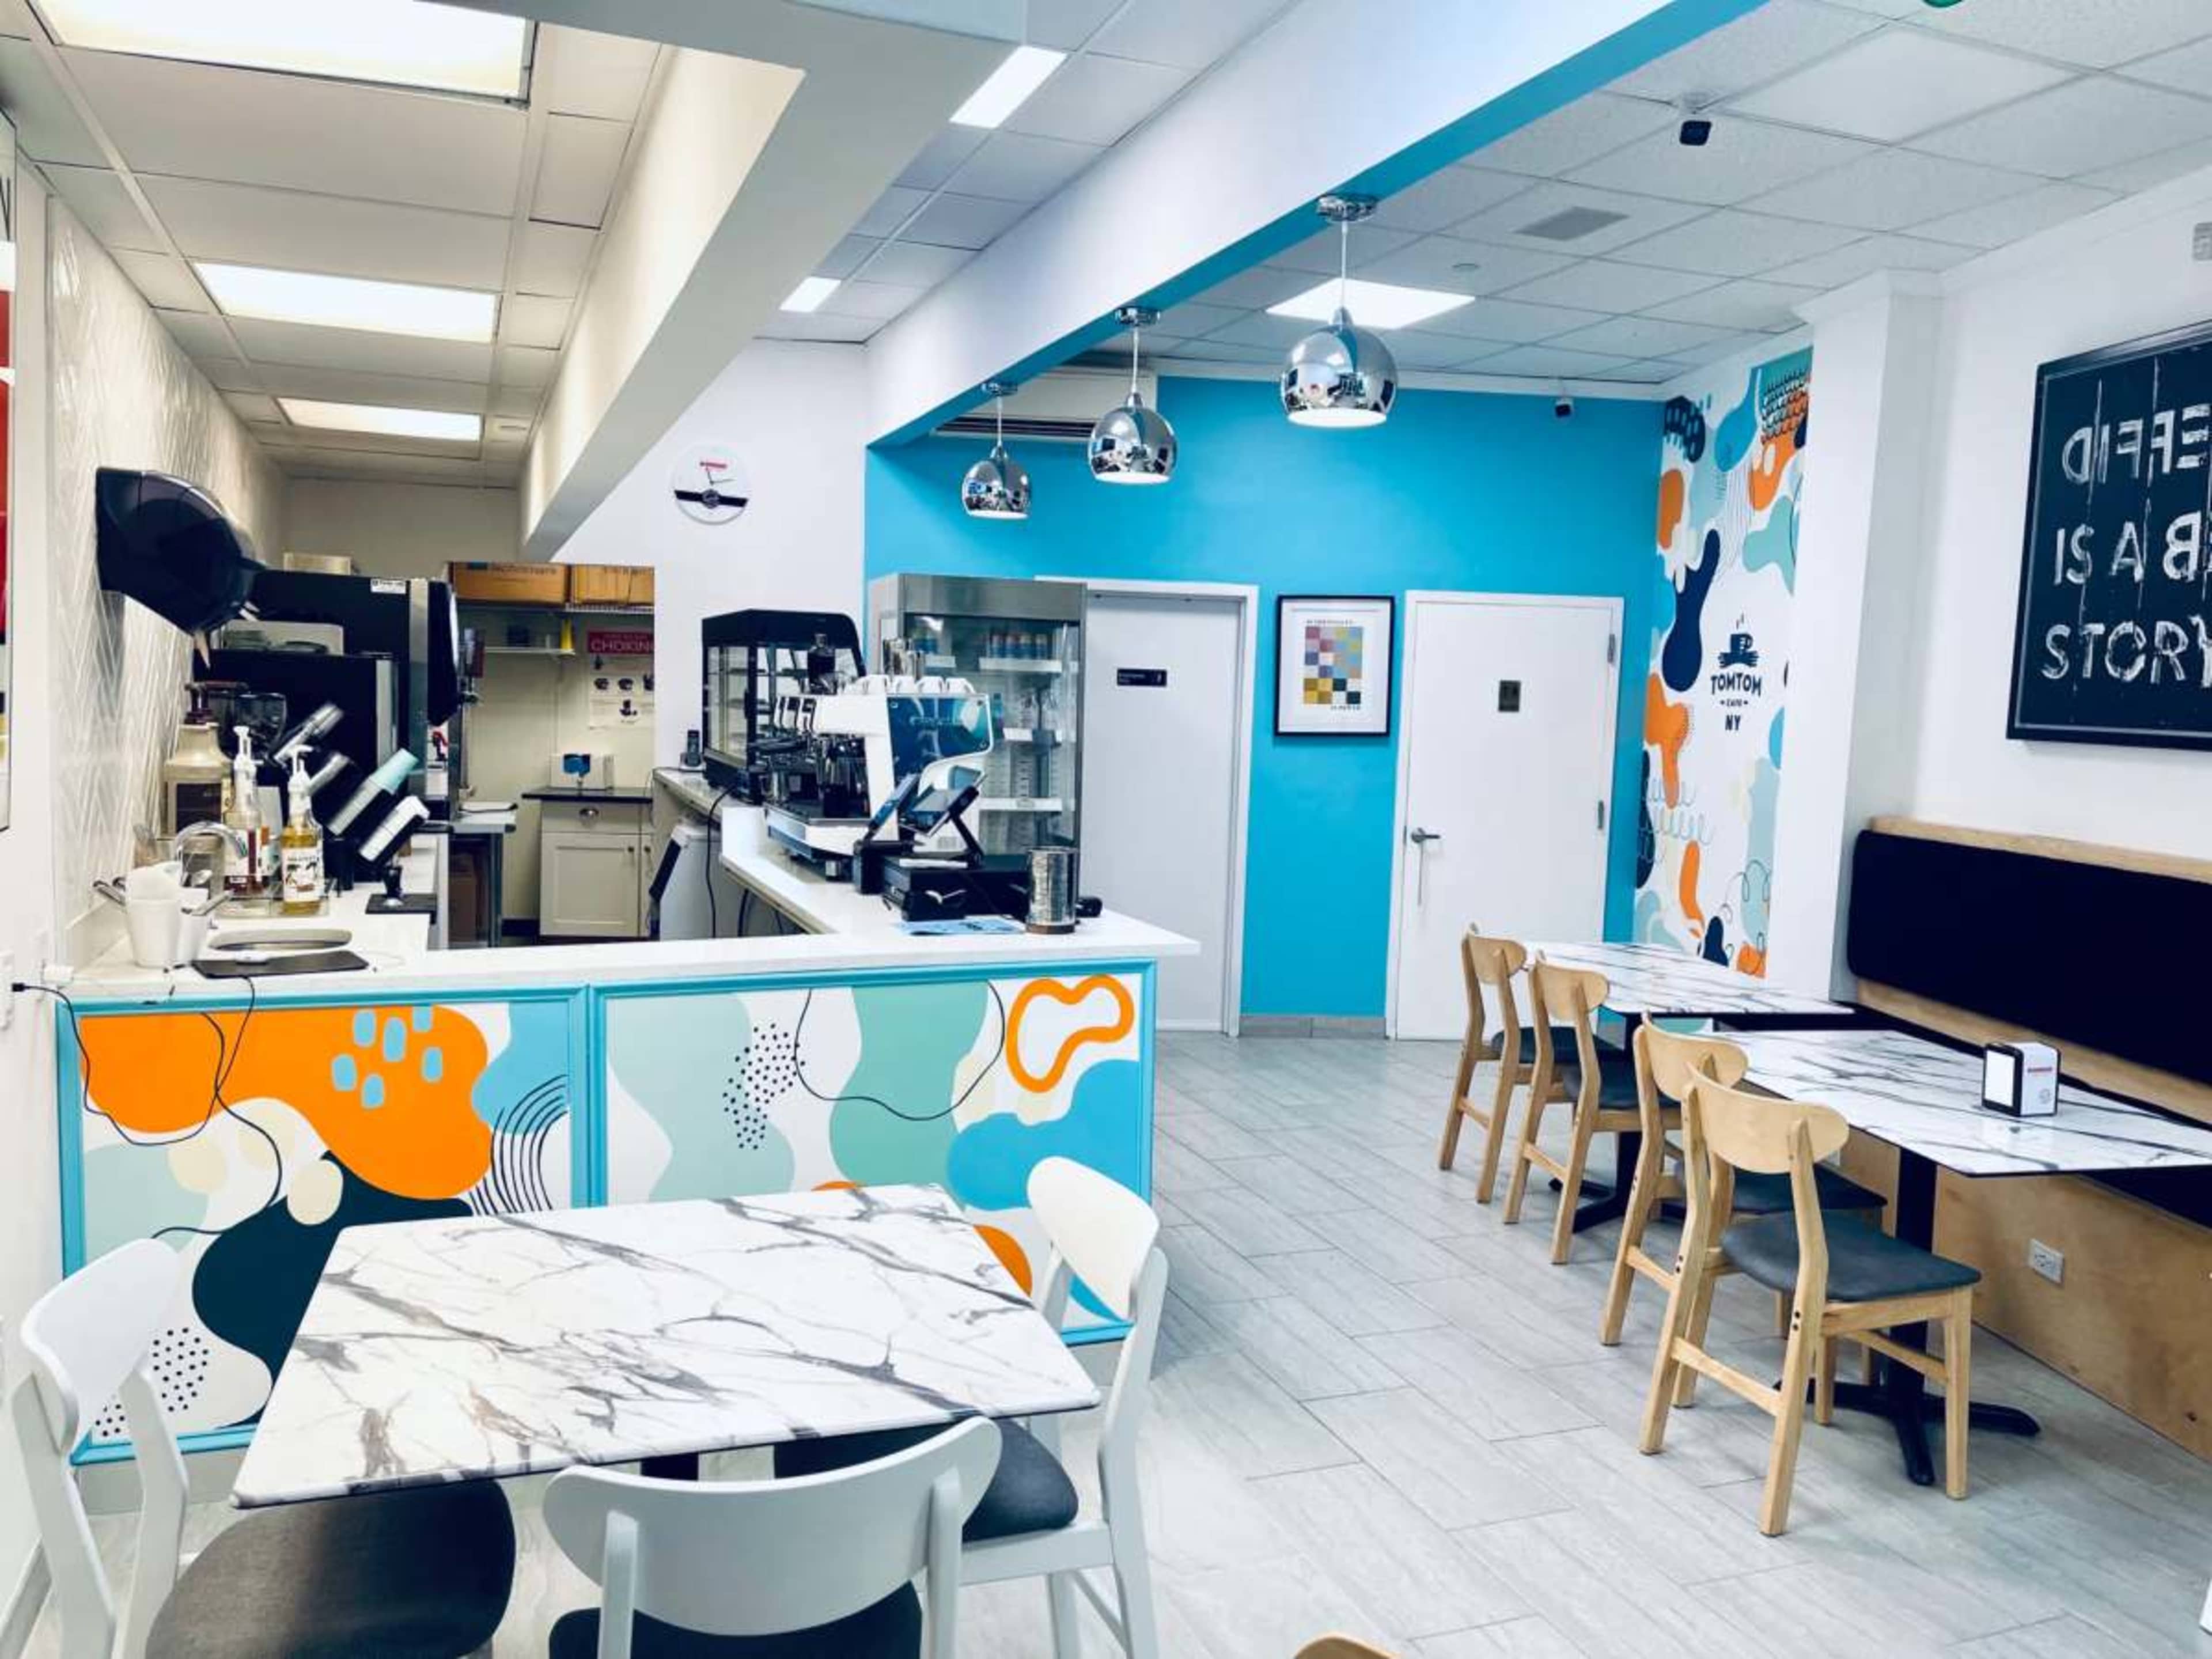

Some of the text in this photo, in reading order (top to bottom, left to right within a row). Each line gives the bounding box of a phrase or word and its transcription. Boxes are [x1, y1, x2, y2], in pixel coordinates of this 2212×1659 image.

[2054, 510, 2212, 586] IS A B
[2041, 614, 2212, 688] STORY
[1710, 672, 1762, 697] TOMTOM
[1725, 714, 1741, 731] NY
